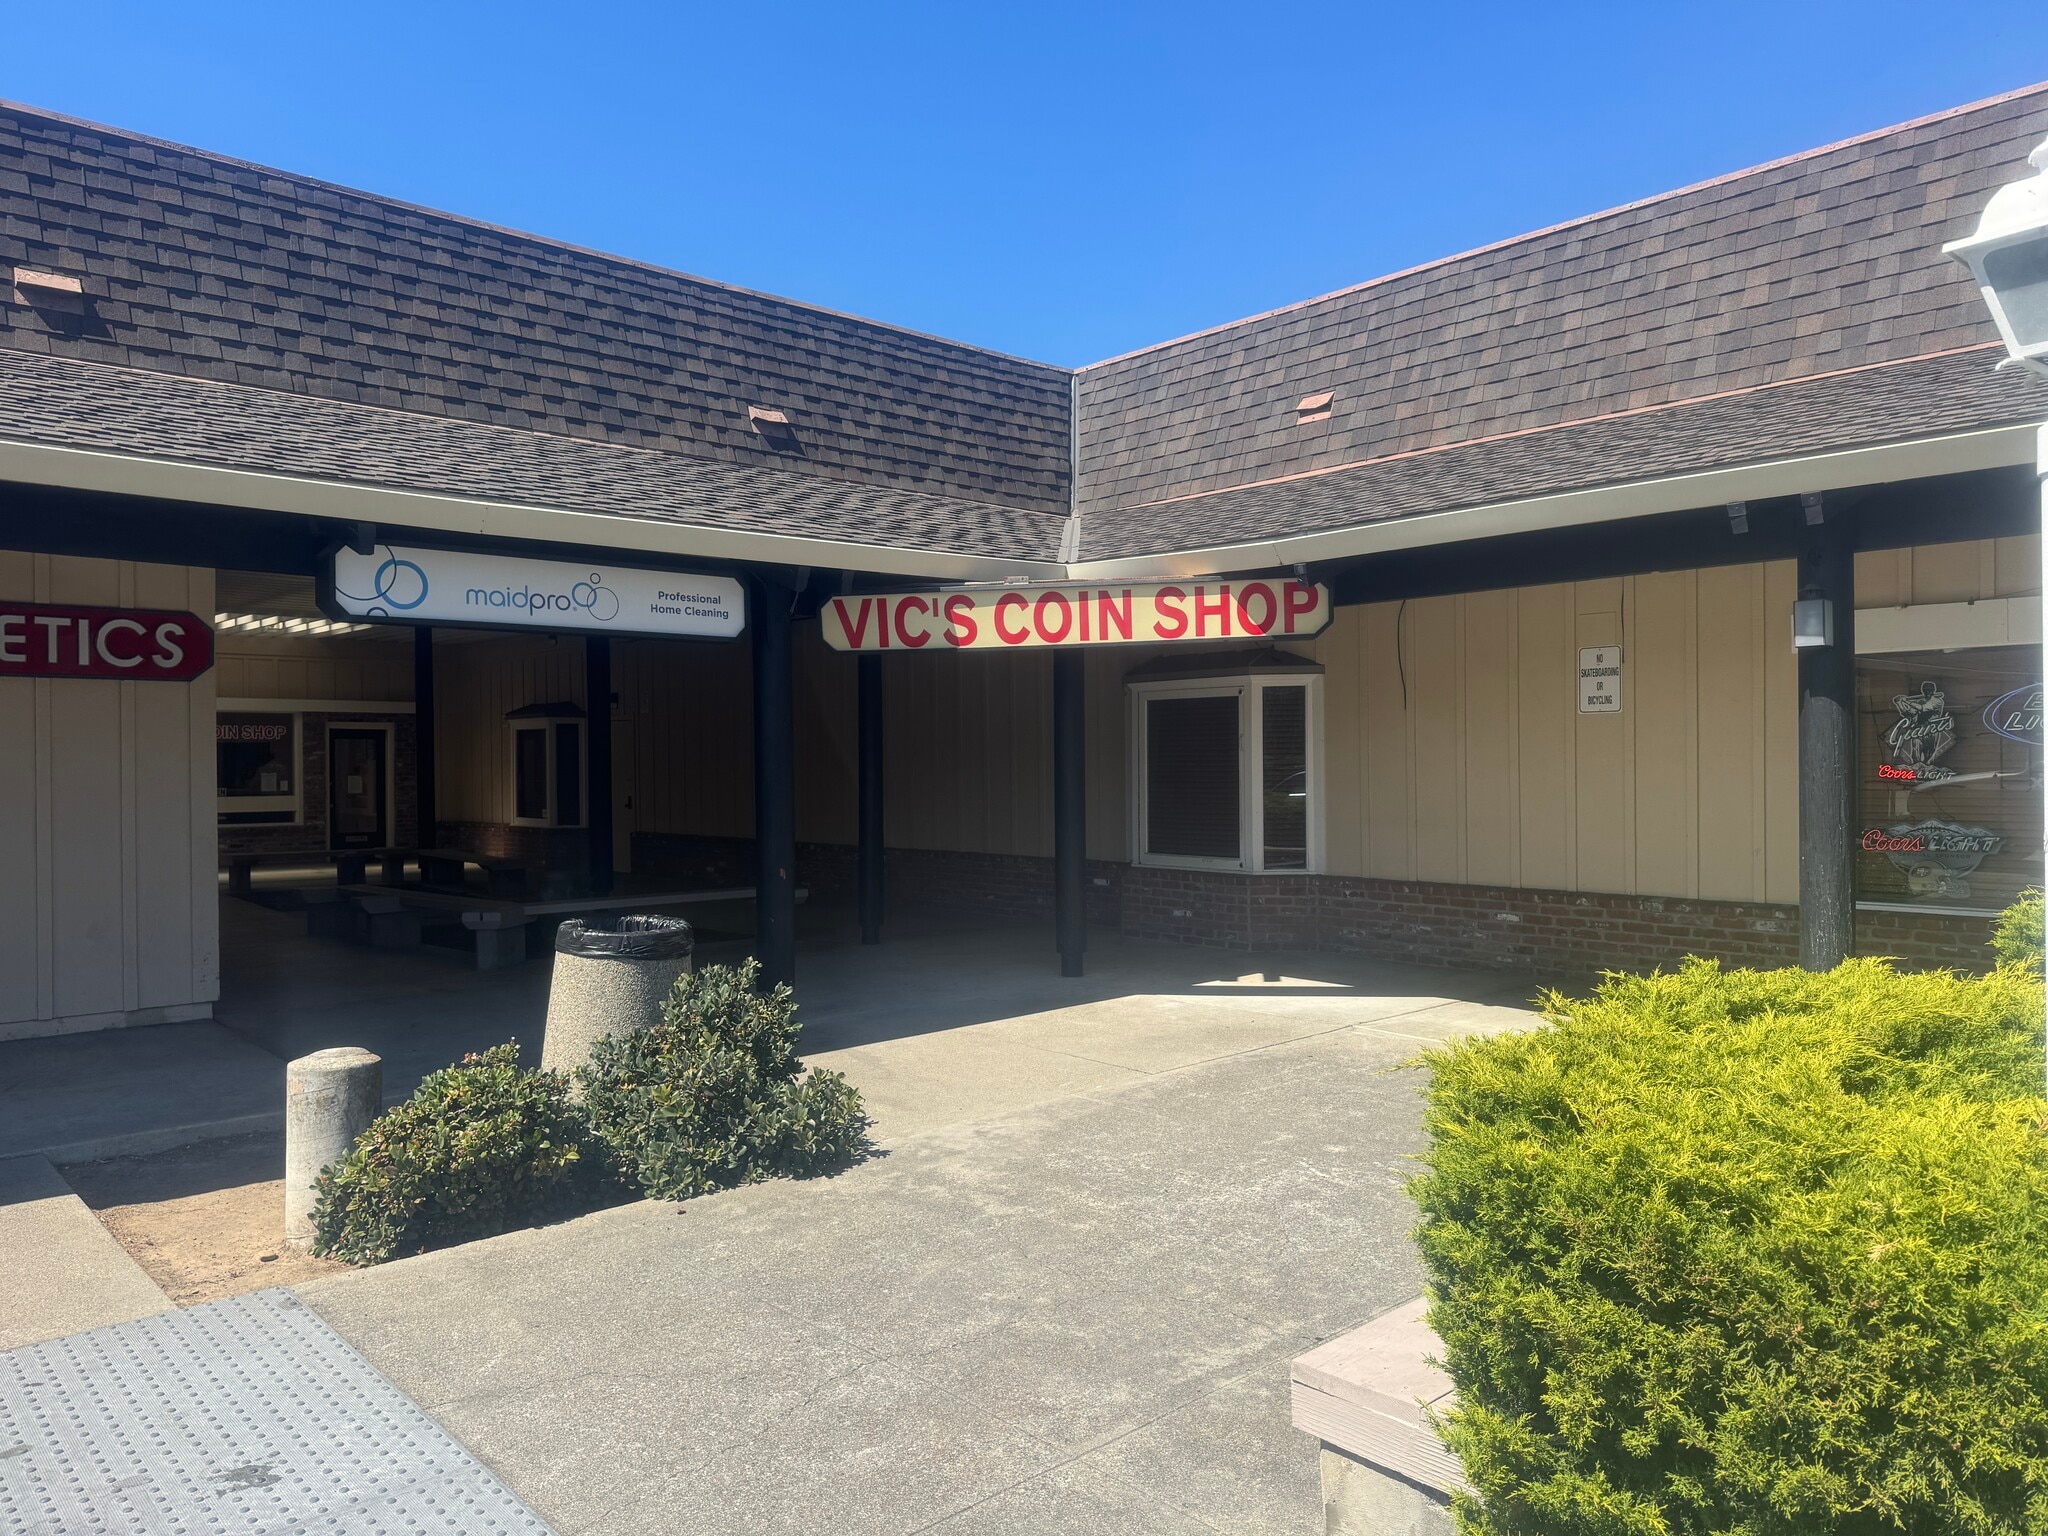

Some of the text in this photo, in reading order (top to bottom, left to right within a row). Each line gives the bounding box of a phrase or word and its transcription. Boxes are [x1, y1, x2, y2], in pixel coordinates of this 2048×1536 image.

[466, 585, 571, 616] maidpro
[657, 590, 721, 605] Professional
[650, 603, 729, 620] Home Cleaning
[832, 581, 1320, 649] VIC'S COIN SHOP
[0, 614, 186, 669] ETICS
[1596, 653, 1604, 663] NO
[1580, 666, 1619, 678] SKATEBOARDING
[1596, 681, 1604, 691] OR
[1587, 695, 1613, 705] BICYCLING
[241, 725, 287, 740] SHOP
[1878, 764, 1957, 781] Coors LIGHT
[1861, 829, 2001, 852] Coors LIGHT
